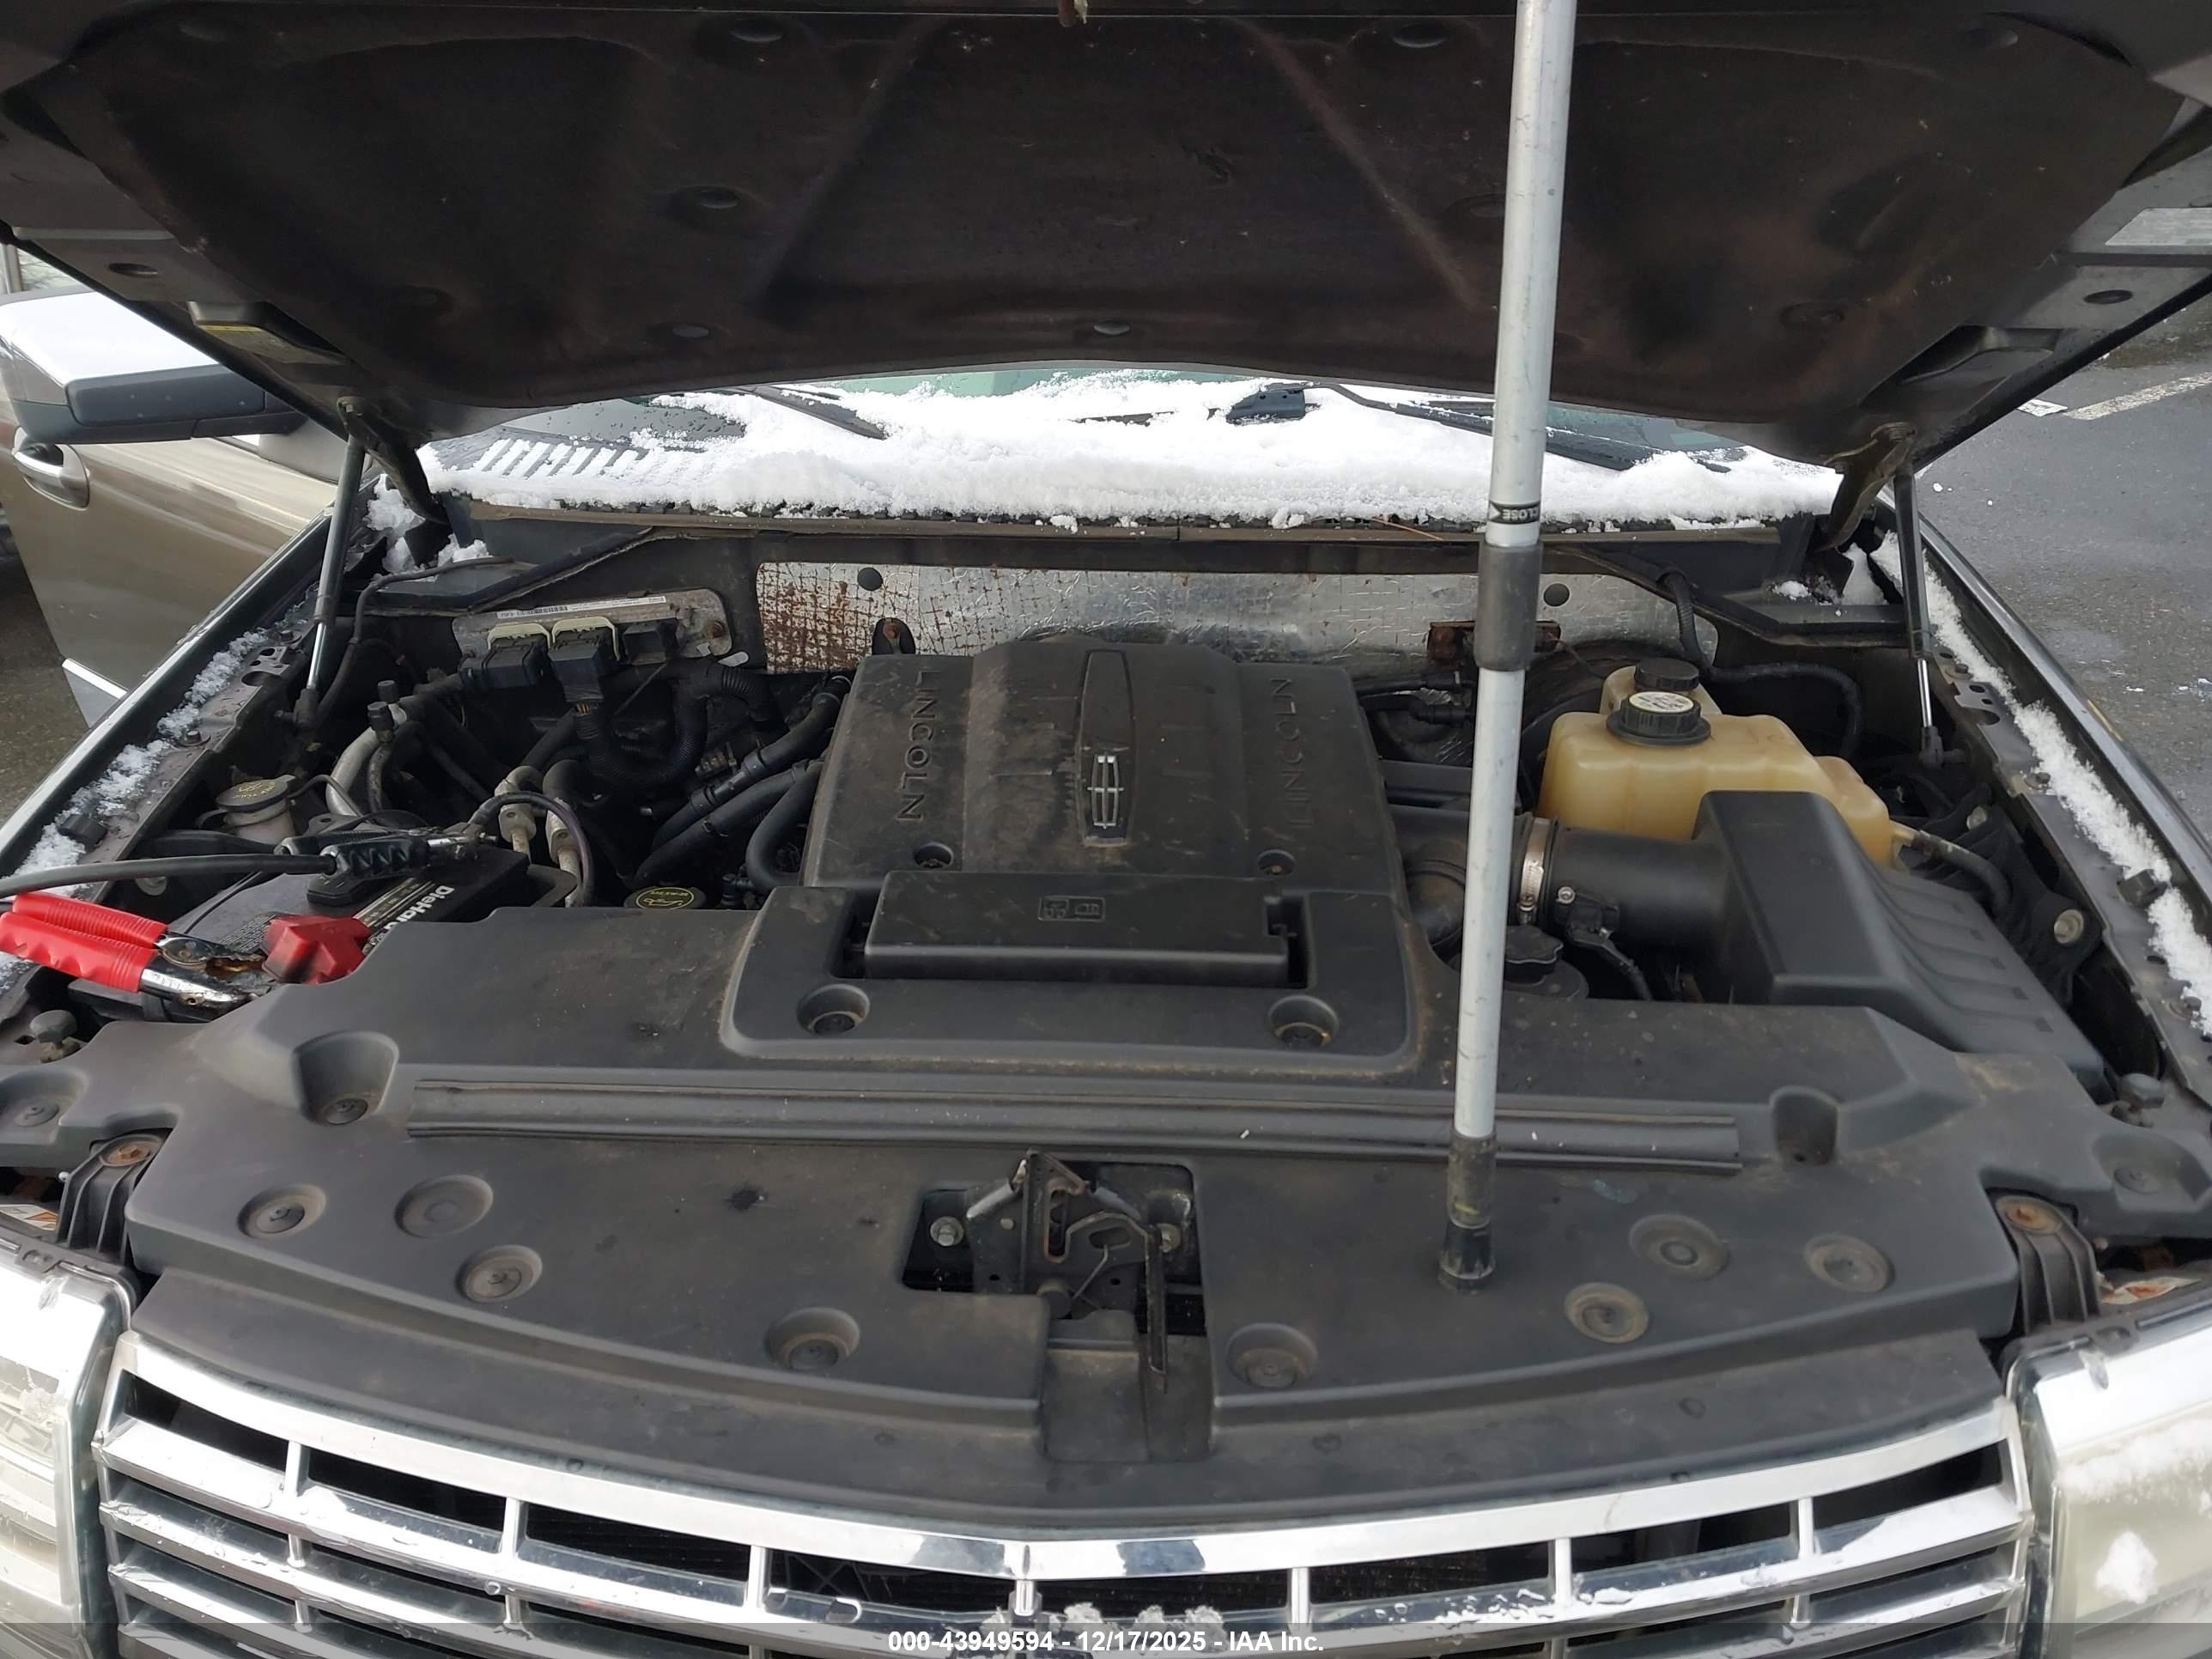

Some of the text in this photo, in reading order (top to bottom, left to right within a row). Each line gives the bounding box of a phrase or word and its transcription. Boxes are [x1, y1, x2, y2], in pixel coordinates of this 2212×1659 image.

[1503, 507, 1540, 520] CLOSE
[896, 669, 942, 823] LINCOLN
[1270, 677, 1315, 830] LINCOLN
